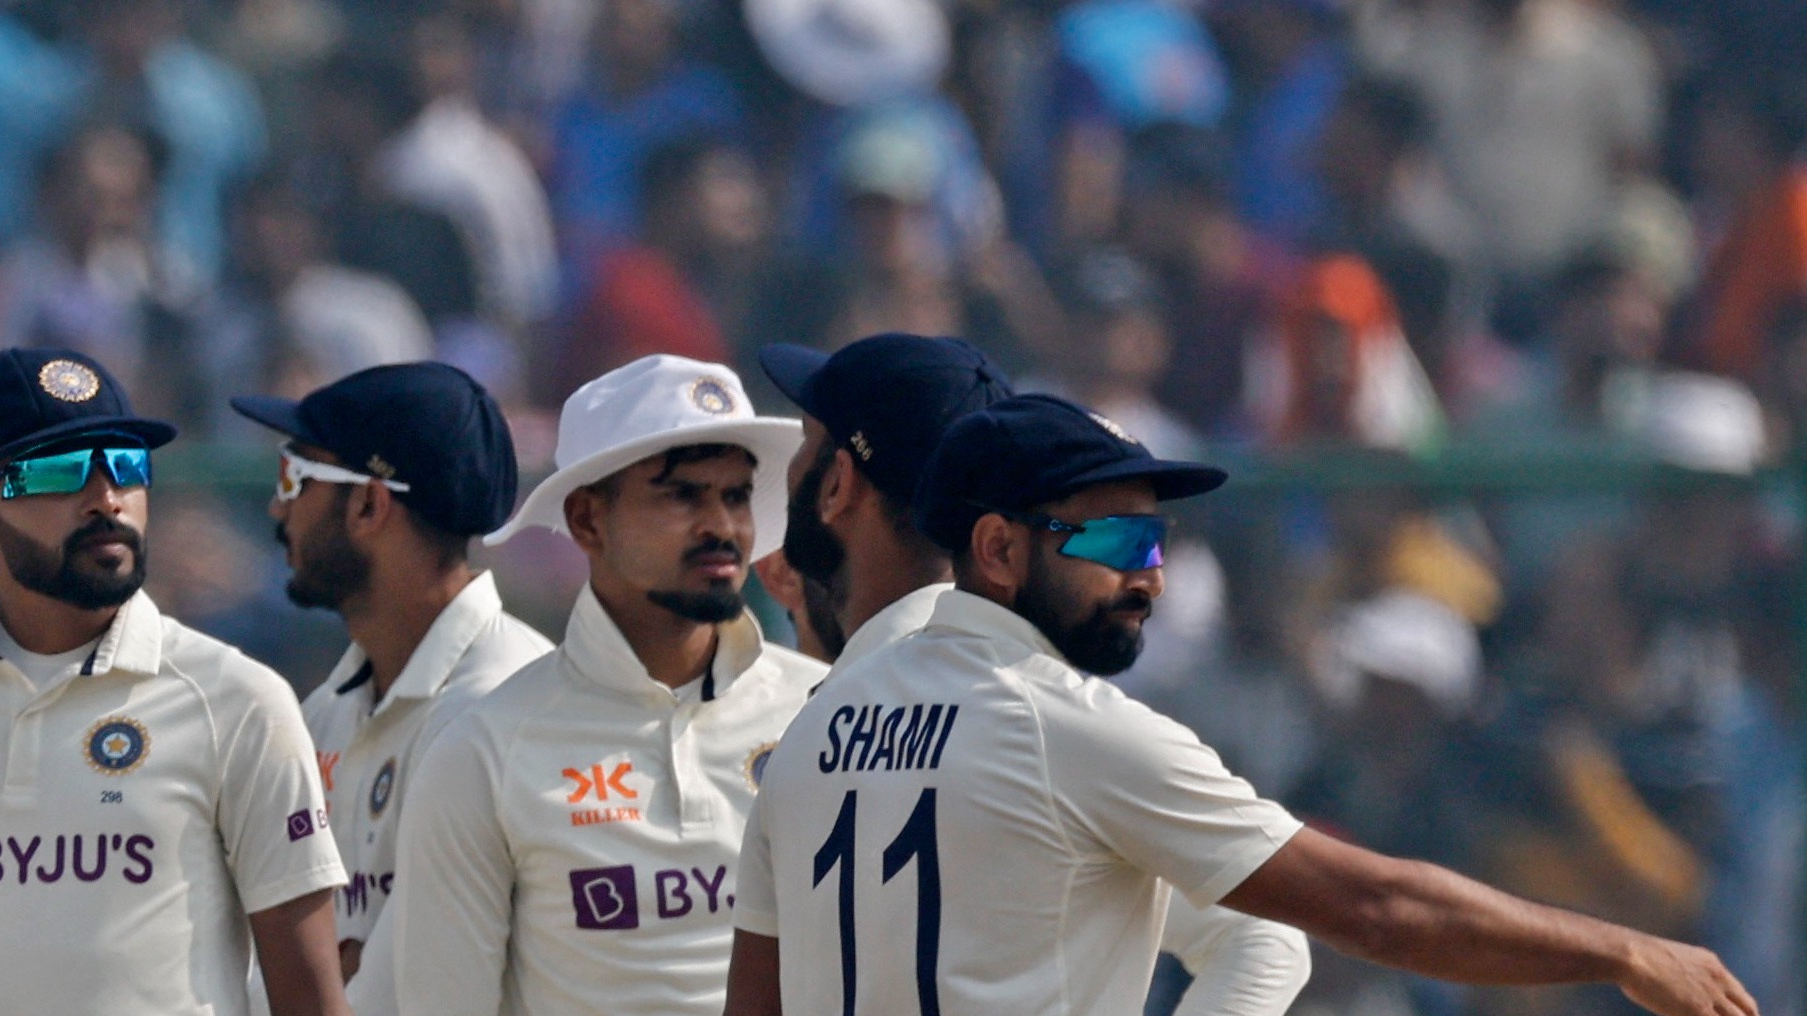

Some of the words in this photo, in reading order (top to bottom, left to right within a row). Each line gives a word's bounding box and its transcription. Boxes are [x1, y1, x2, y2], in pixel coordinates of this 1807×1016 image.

[819, 703, 960, 774] SHAMI
[100, 790, 124, 804] 298
[570, 807, 640, 827] KILLER
[654, 864, 736, 919] BY
